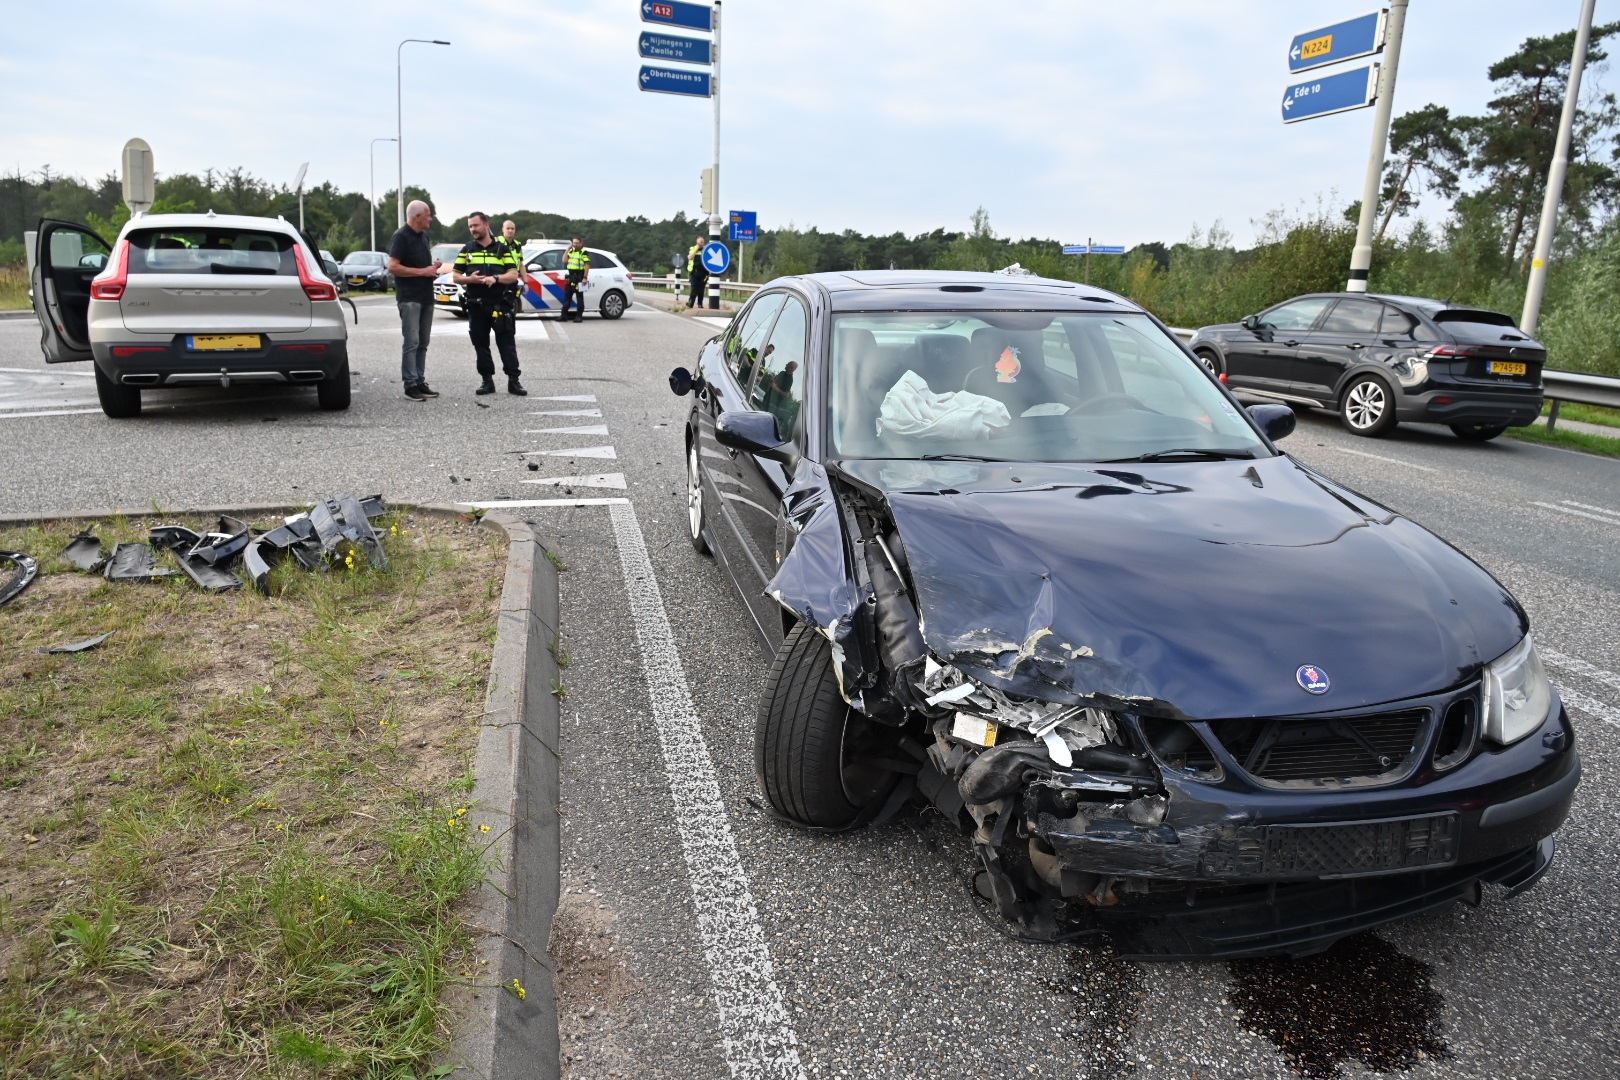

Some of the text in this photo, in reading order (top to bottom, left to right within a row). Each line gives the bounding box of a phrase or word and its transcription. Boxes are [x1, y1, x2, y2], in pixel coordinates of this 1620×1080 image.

[650, 37, 683, 48] Nijmegen
[650, 47, 674, 56] Zwolle
[649, 69, 692, 82] Oberhausen
[1294, 84, 1320, 98] Ede 10
[1493, 362, 1523, 373] P-745-FS
